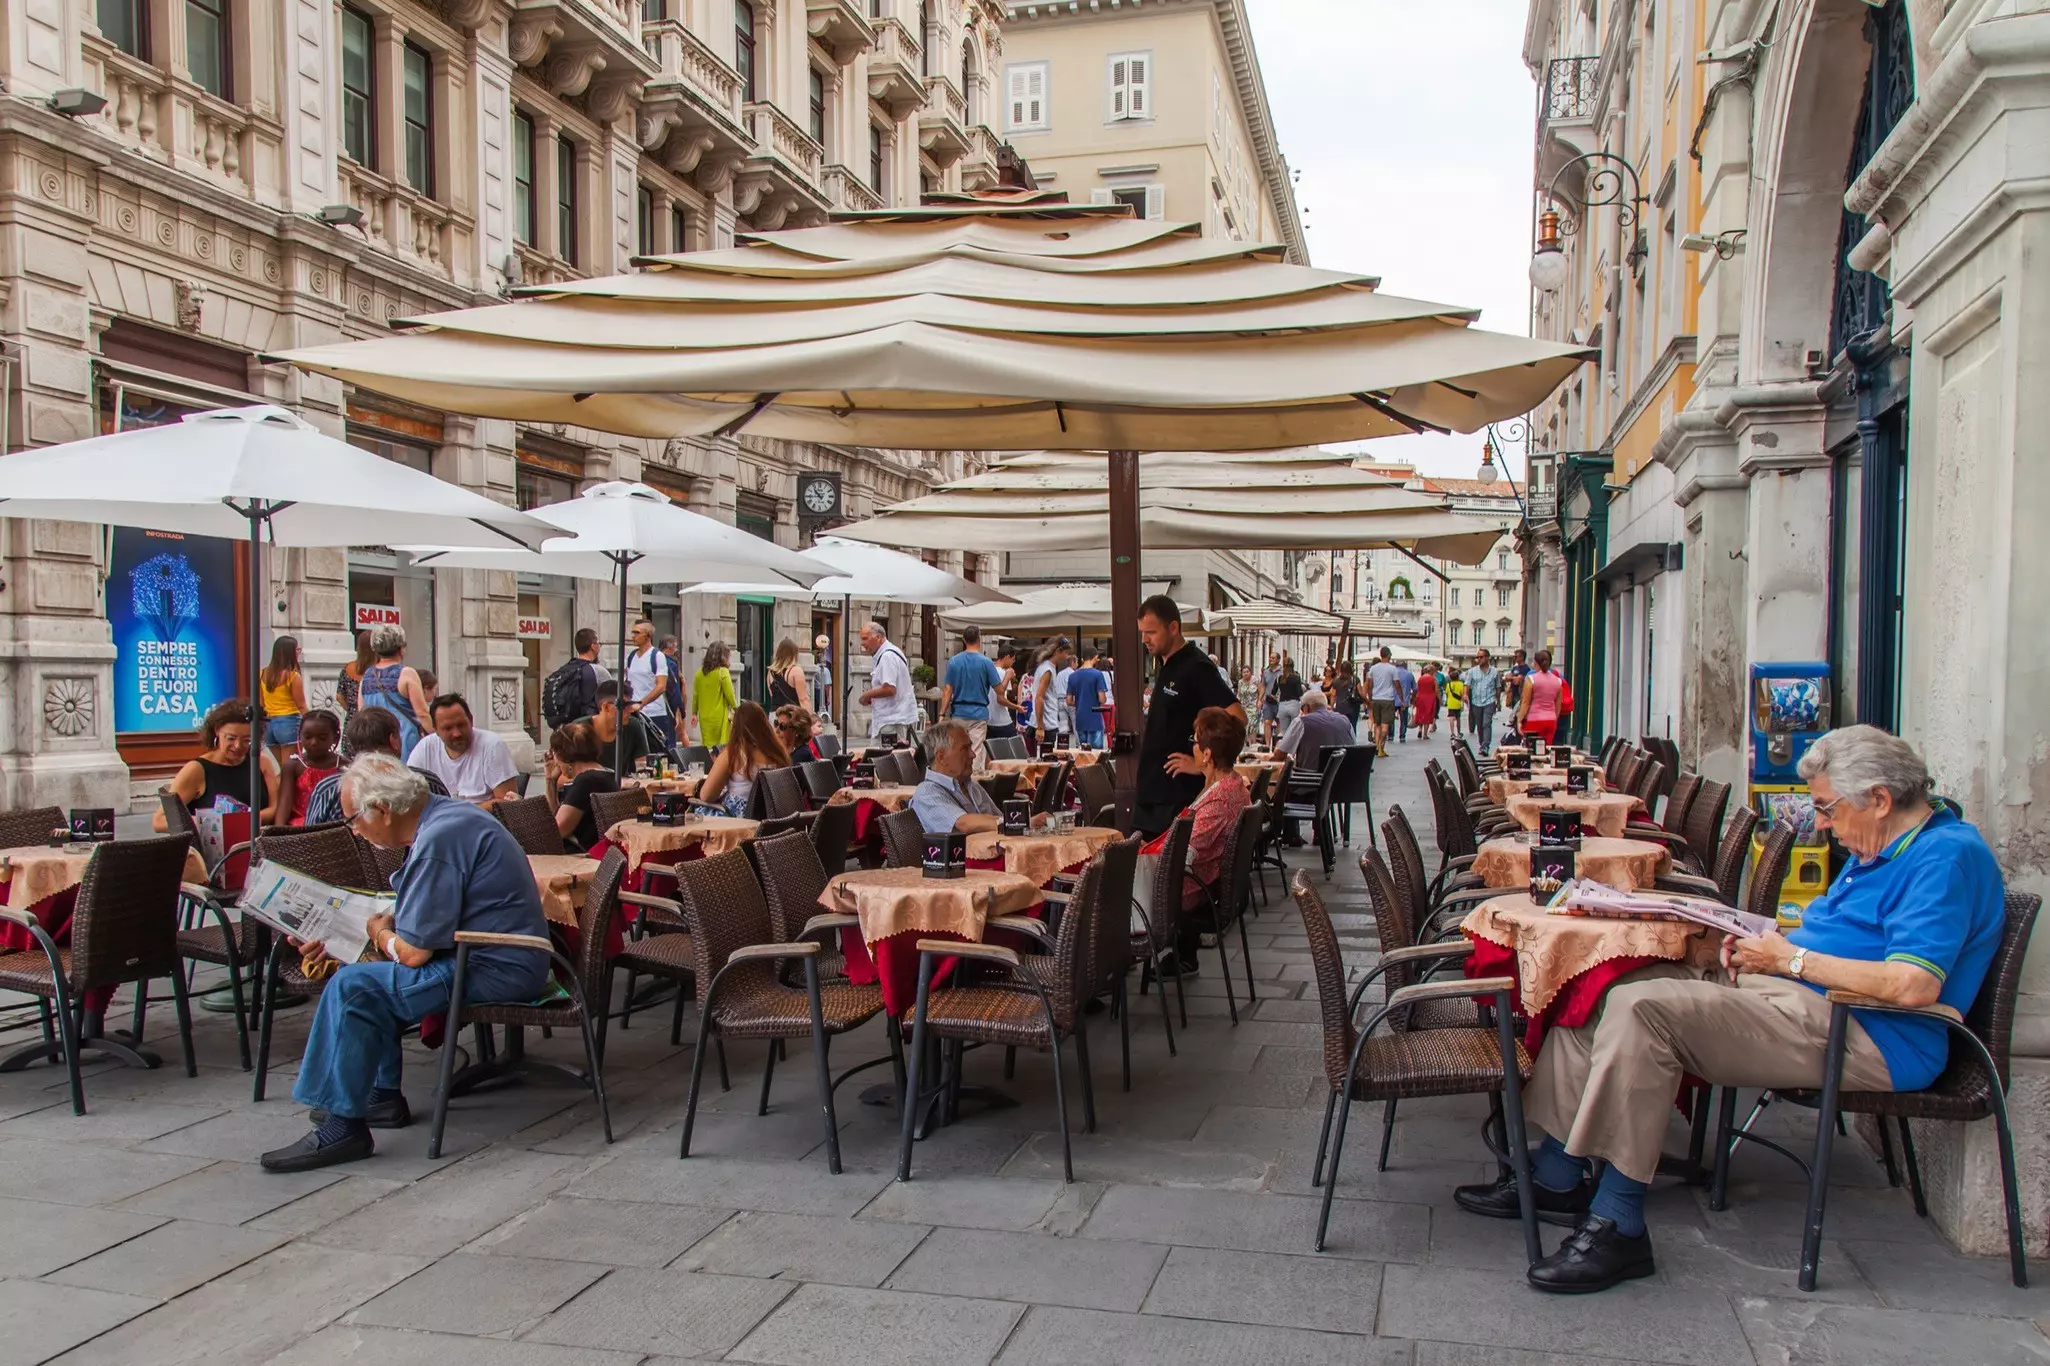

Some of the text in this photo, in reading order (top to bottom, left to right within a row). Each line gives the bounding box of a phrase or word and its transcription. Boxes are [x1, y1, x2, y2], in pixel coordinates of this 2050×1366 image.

[1531, 459, 1551, 493] T
[145, 530, 185, 540] INFOSTRADA
[357, 607, 400, 625] SALDI
[518, 619, 550, 635] SALDI
[137, 641, 197, 655] SEMPRE
[138, 655, 197, 666] CONNESSO
[138, 666, 198, 679] DENTRO
[139, 680, 198, 693] E FUORI
[140, 694, 198, 714] CASA
